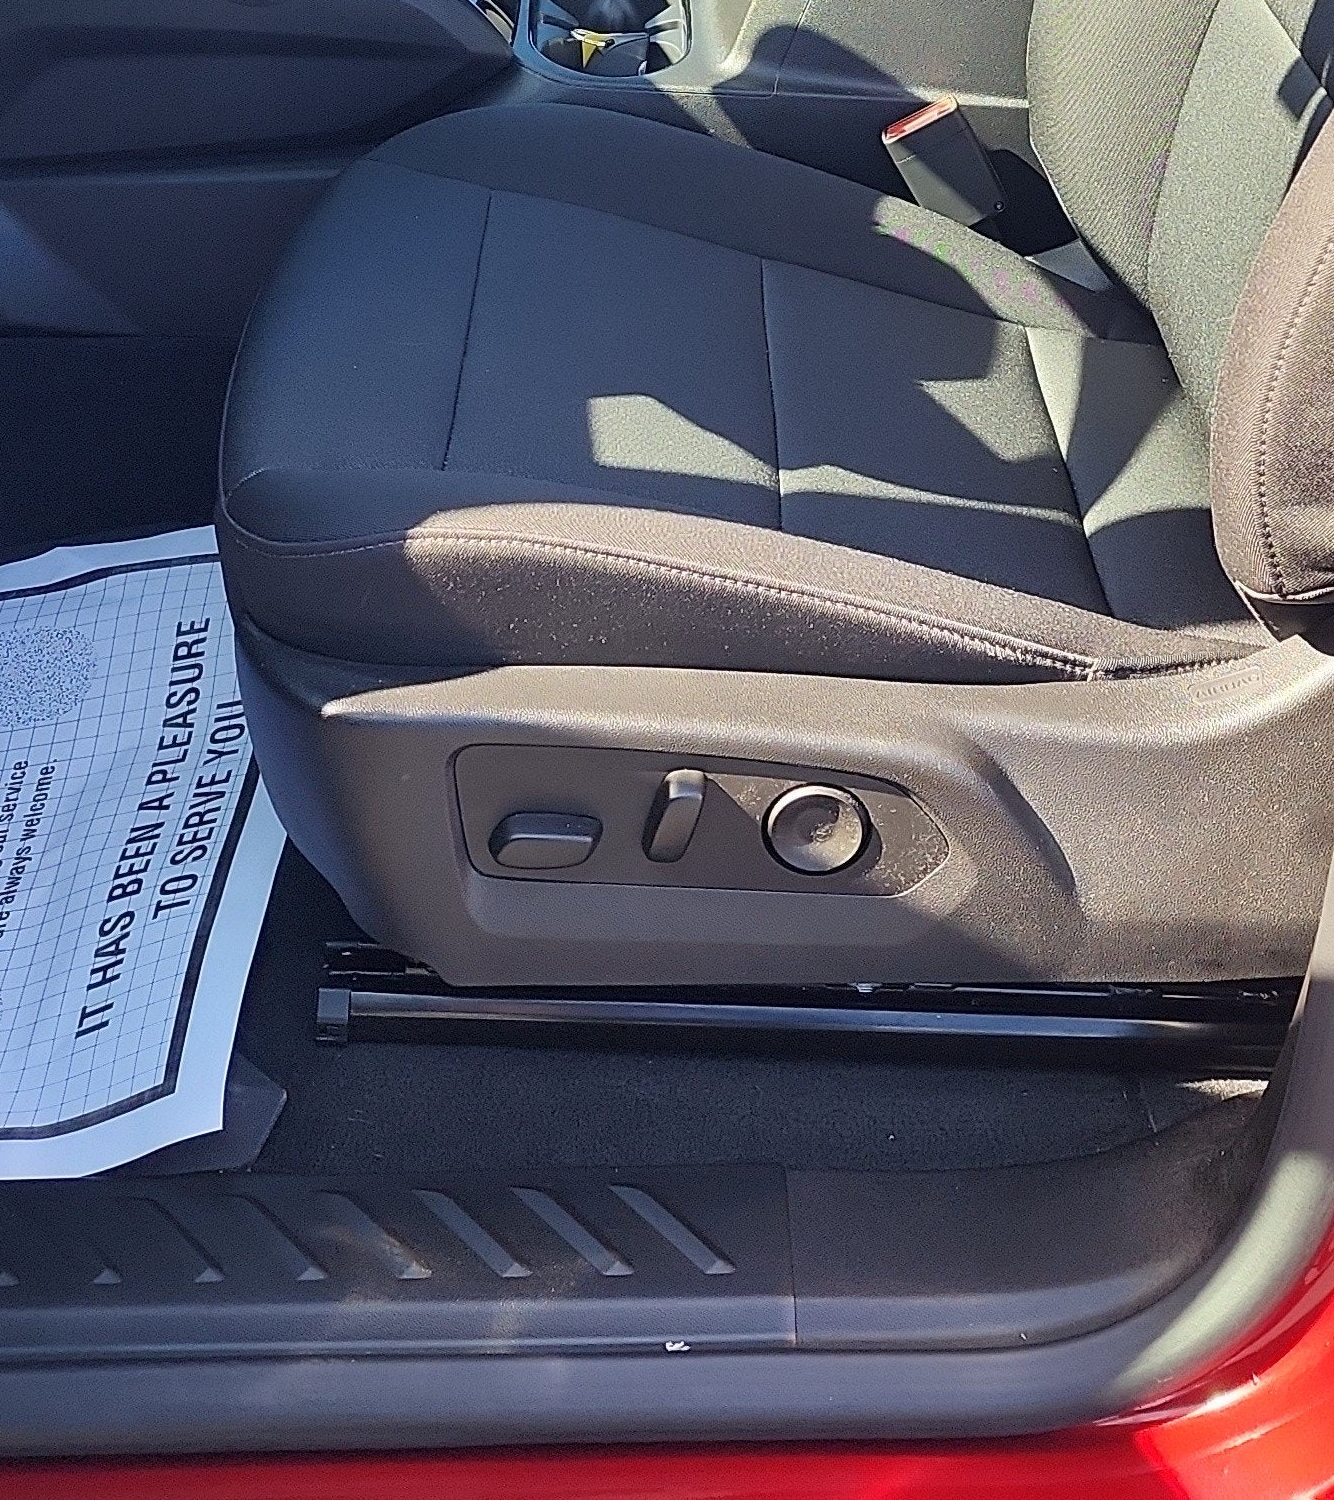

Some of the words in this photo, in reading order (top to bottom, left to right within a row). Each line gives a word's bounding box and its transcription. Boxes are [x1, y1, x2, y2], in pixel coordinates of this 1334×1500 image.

[145, 617, 211, 787] PLEASURE
[20, 758, 58, 842] welcome.
[137, 791, 175, 811] A
[170, 769, 233, 866] SERVE
[107, 820, 166, 904] BEEN
[152, 873, 199, 920] TO
[87, 910, 135, 992] HAS
[74, 1001, 114, 1040] IT
